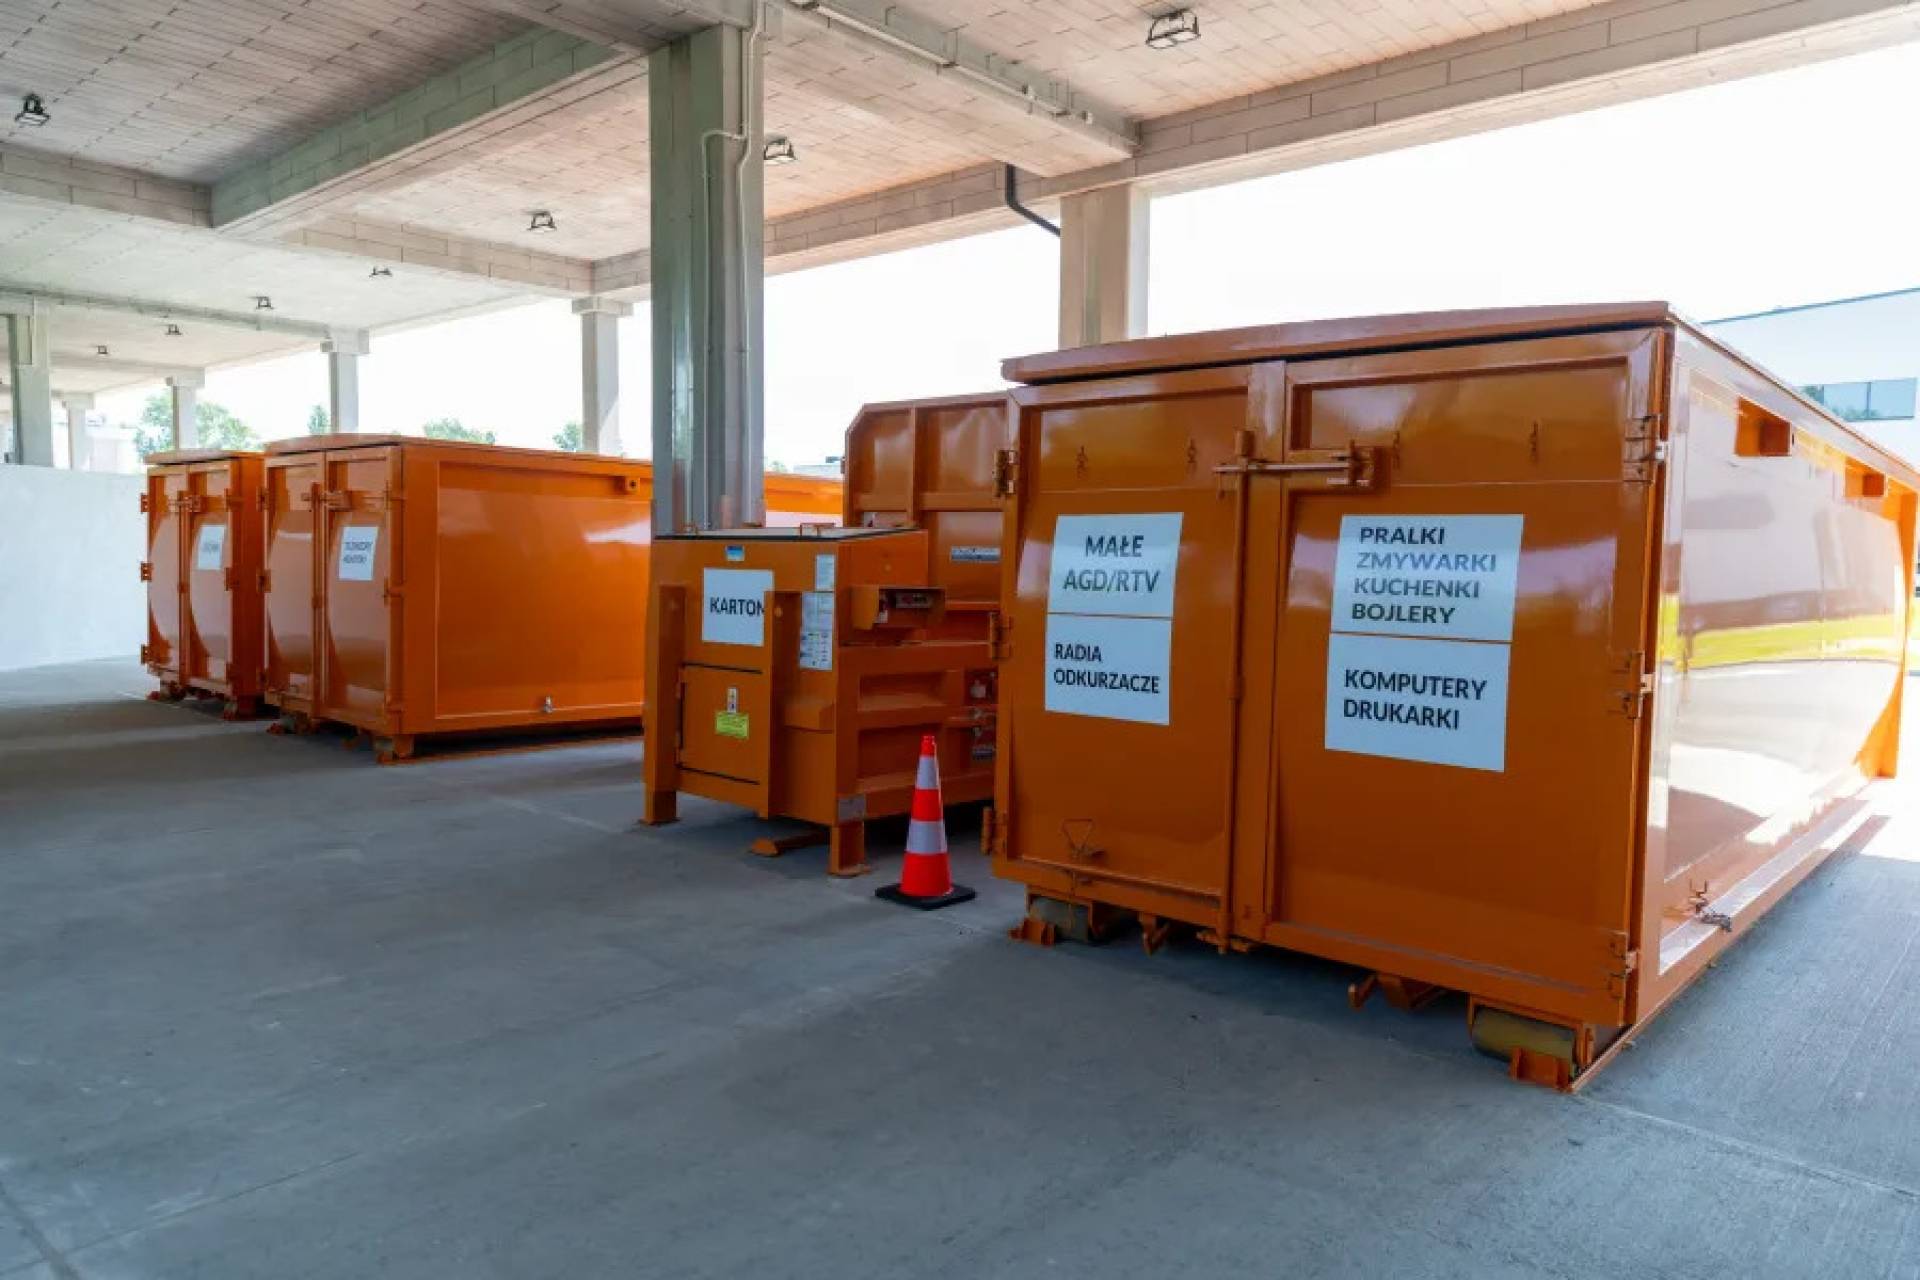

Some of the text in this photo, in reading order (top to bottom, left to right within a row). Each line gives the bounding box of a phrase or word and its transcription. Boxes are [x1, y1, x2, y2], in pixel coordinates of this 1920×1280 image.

[1084, 534, 1145, 558] MAŁE
[1359, 526, 1445, 546] PRALKI
[1356, 551, 1497, 572] ZMYWARKI
[1062, 569, 1161, 594] AGD/RTV
[1353, 578, 1480, 599] KUCHENKI
[1351, 602, 1456, 625] BOJLERY
[1053, 643, 1102, 663] RADIA
[1053, 667, 1160, 695] ODKURZACZE
[1343, 668, 1488, 701] KOMPUTERY
[1343, 698, 1461, 731] DRUKARKI
